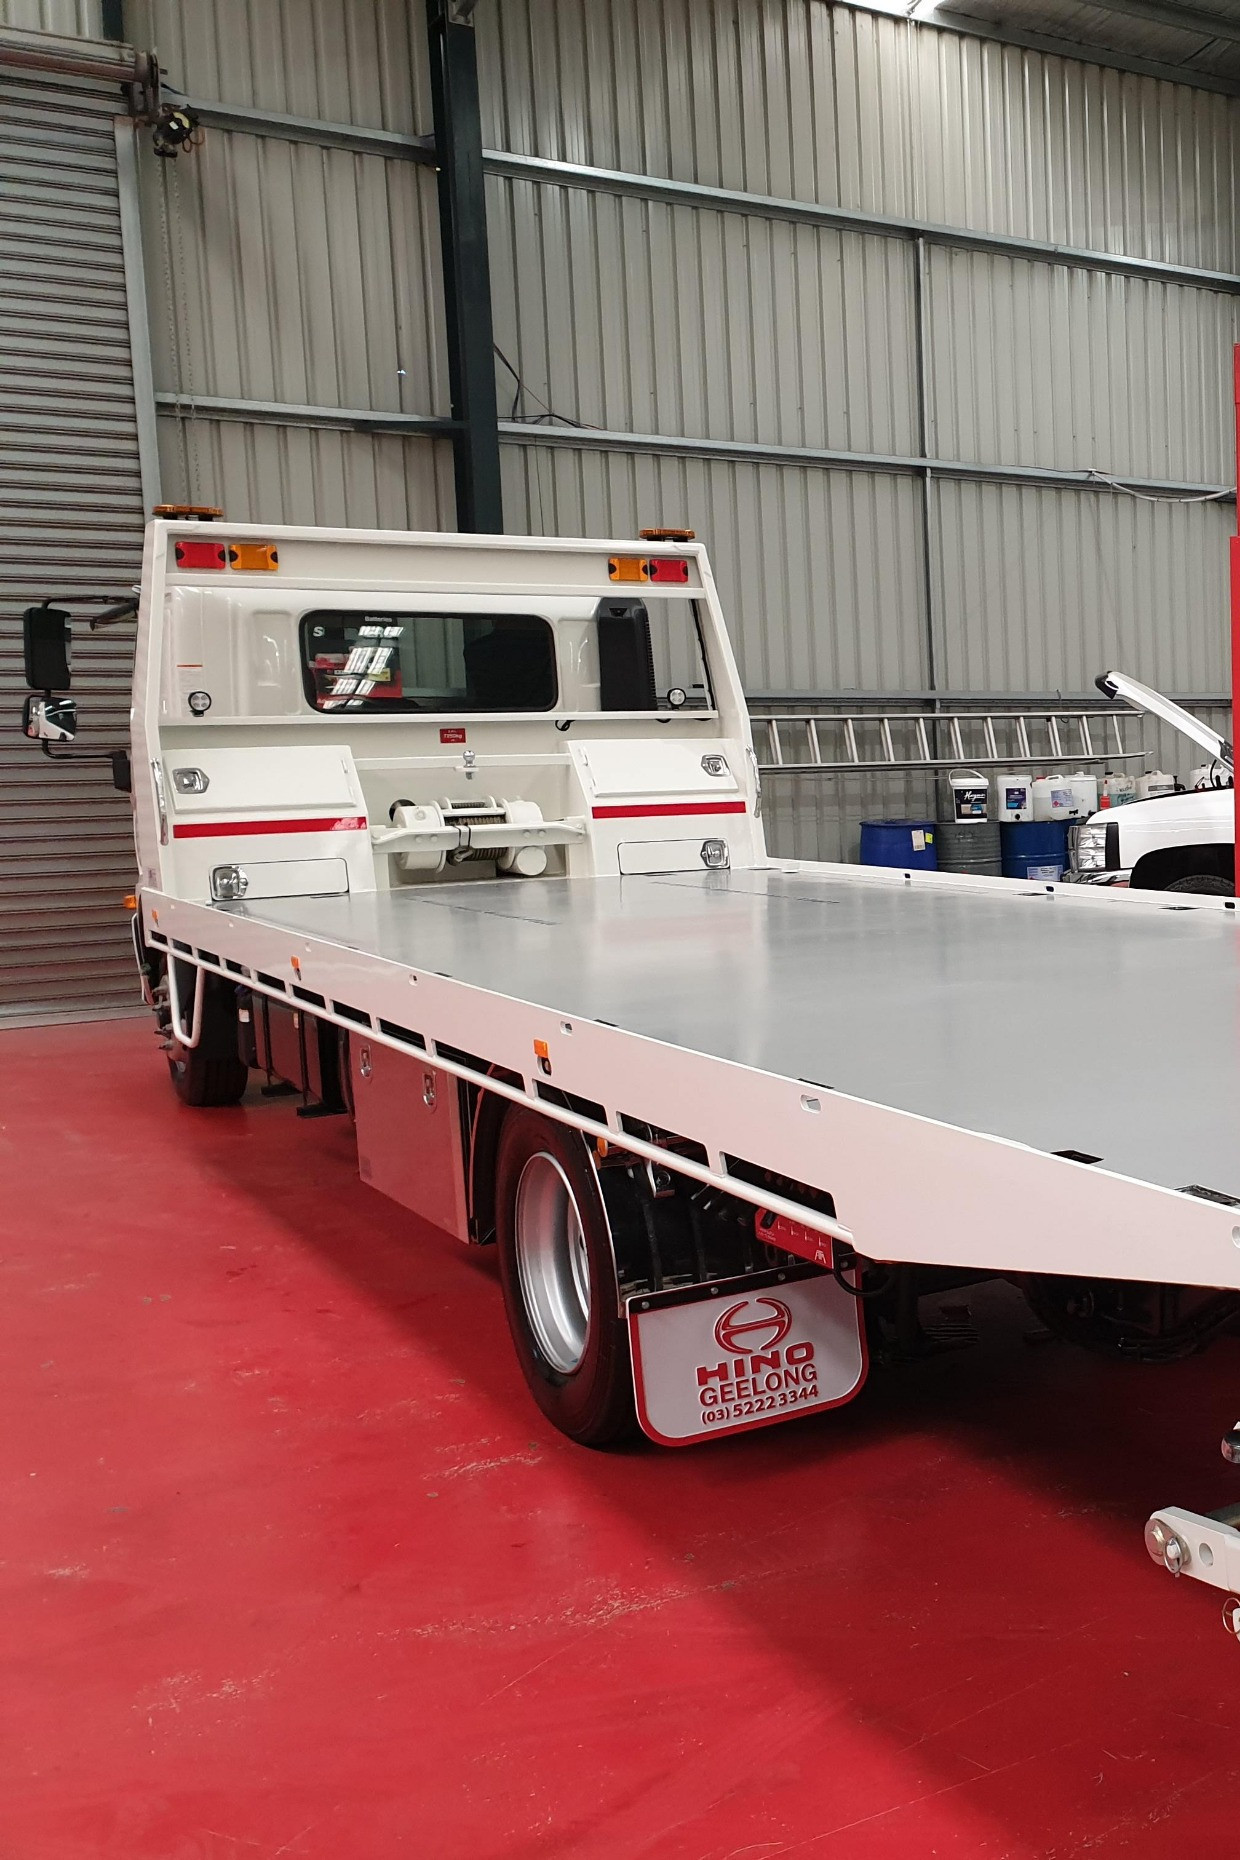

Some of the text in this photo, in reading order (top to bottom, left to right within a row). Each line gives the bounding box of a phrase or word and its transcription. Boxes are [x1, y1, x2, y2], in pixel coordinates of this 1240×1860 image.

[696, 1341, 815, 1386] HINO
[699, 1363, 818, 1407] GEELONG
[701, 1407, 730, 1425] (03)
